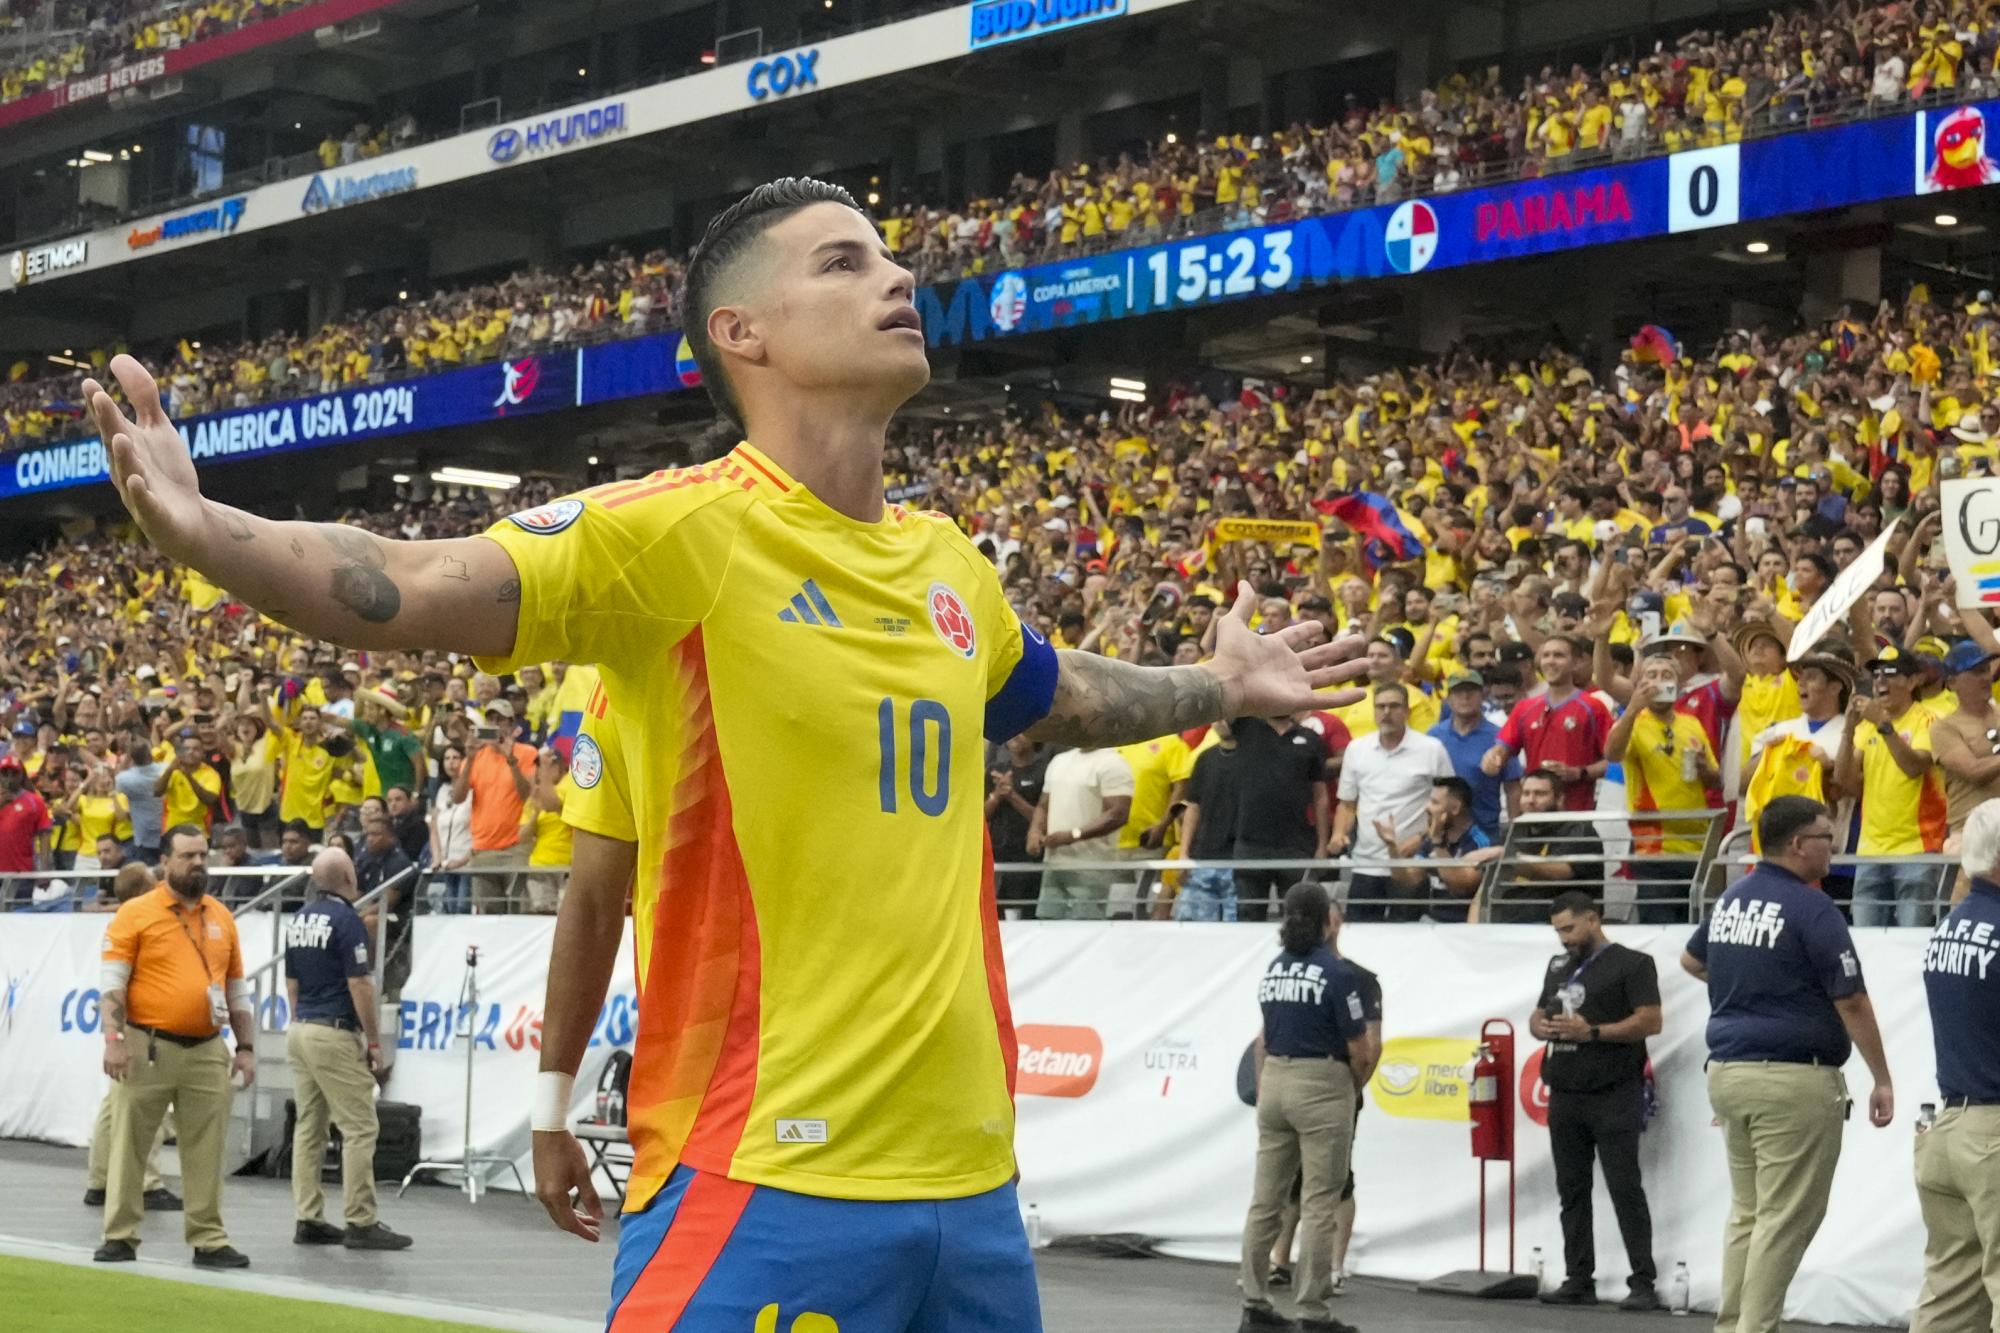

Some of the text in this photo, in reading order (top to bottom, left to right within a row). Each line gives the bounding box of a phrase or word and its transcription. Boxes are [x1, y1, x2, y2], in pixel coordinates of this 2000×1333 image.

[973, 2, 1034, 39] BUD
[68, 73, 108, 103] ERNIE
[110, 56, 165, 90] NEVERS
[747, 49, 819, 100] COX
[526, 102, 626, 150] HYUNDAI
[1477, 165, 1719, 241] PANAMA 0
[26, 240, 88, 276] BETMGM
[1149, 230, 1293, 305] 15:23
[1033, 274, 1119, 303] COPA AMERICA
[16, 441, 109, 487] CONMEB
[192, 408, 296, 459] AMERICA
[302, 400, 348, 439] USA
[353, 387, 413, 432] 2024
[879, 696, 951, 817] 10
[1708, 916, 1783, 949] SECURITY
[1924, 940, 1996, 979] ECURITY
[1260, 978, 1325, 1005] ECURITY
[1144, 1051, 1199, 1071] ULTRA
[1426, 1064, 1464, 1079] merc
[1424, 1080, 1459, 1096] libre
